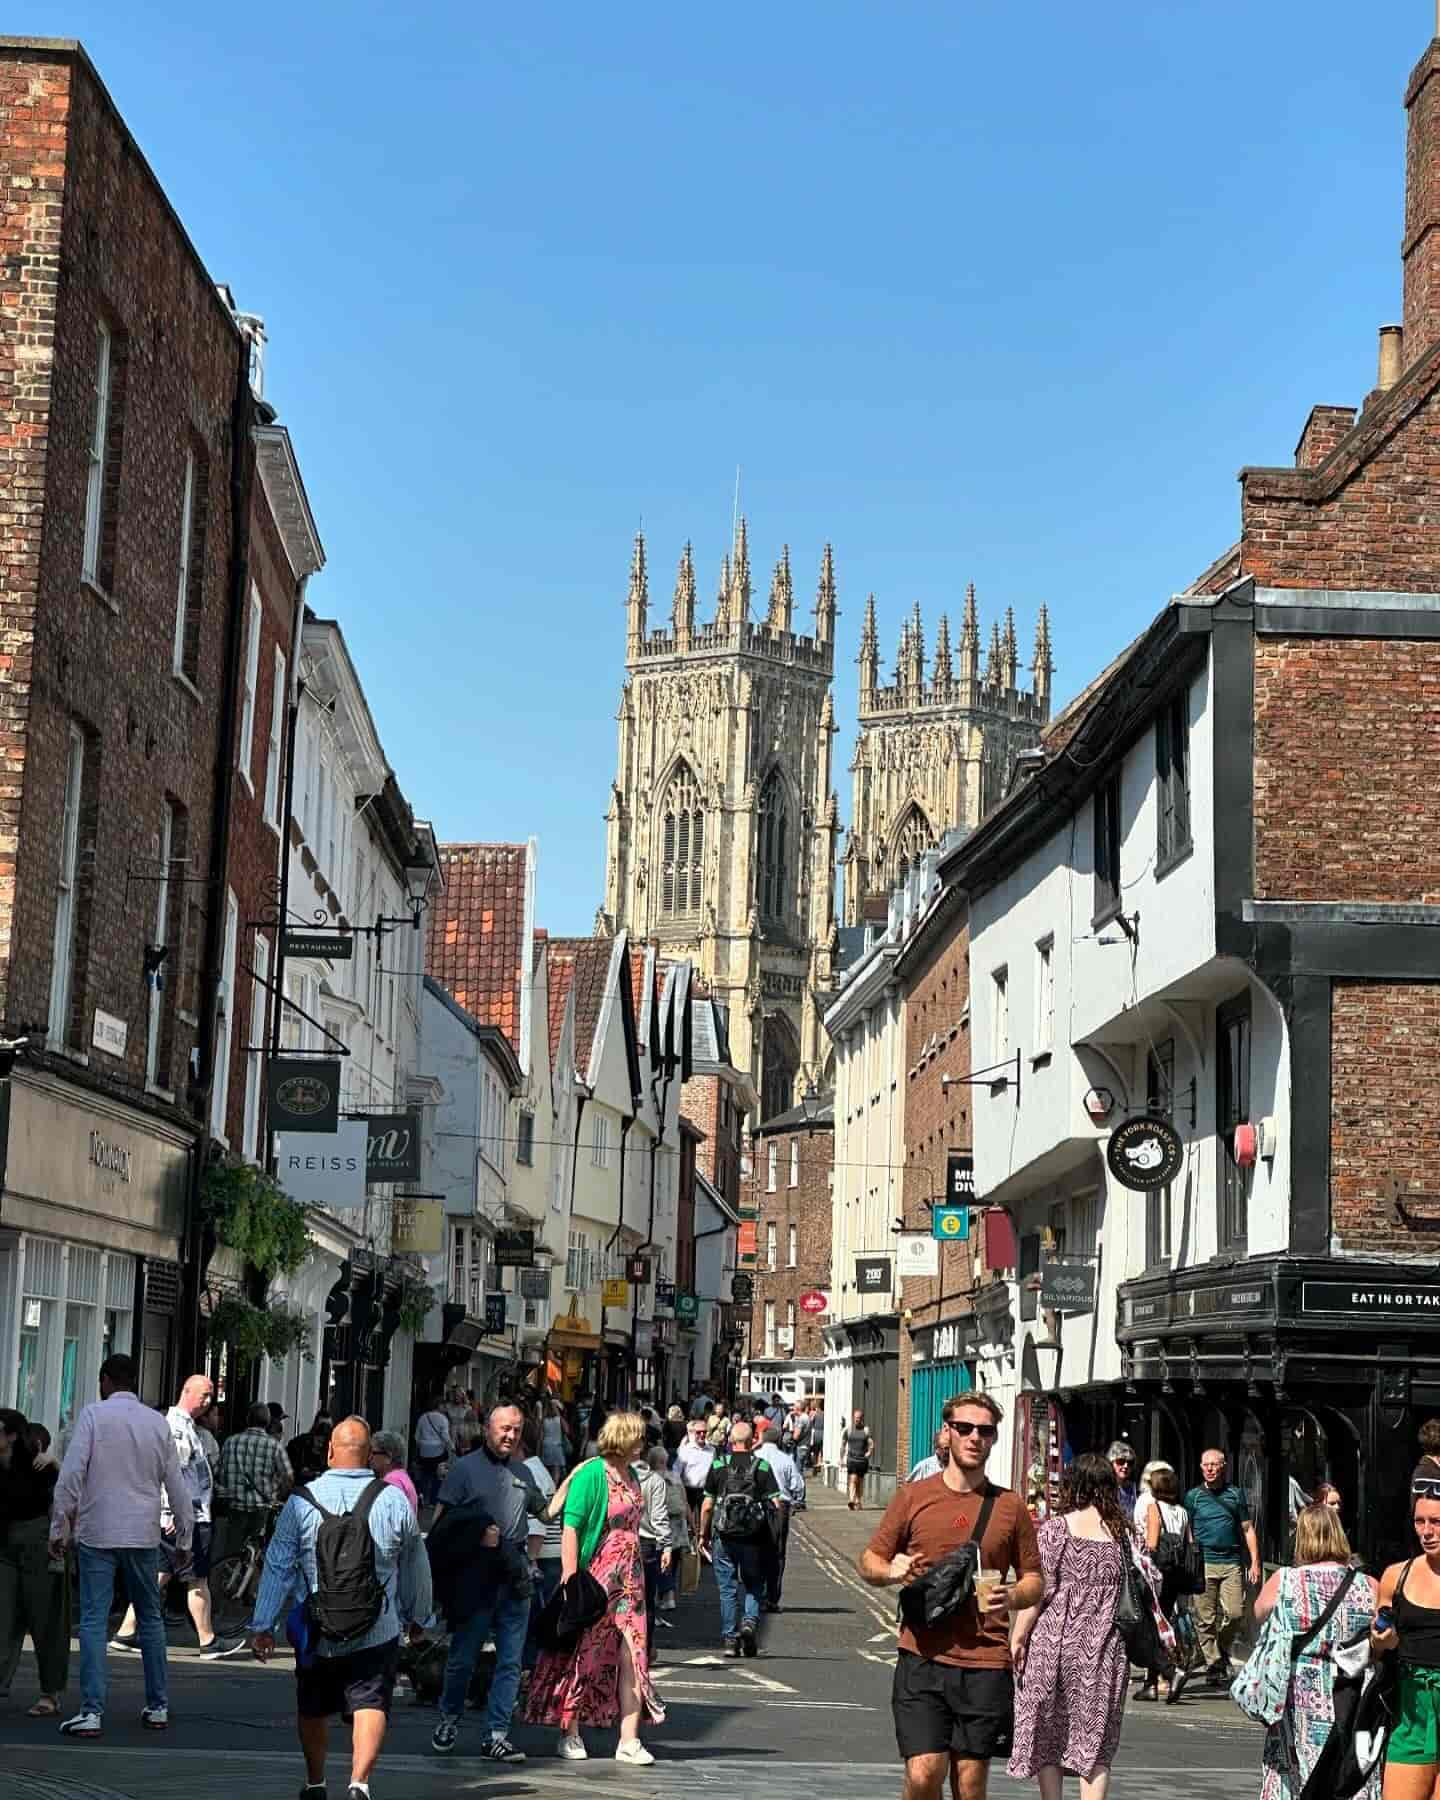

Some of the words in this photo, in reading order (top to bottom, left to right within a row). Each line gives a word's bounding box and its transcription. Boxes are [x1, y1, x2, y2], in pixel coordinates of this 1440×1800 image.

[288, 1155, 357, 1171] REISS
[1352, 1293, 1375, 1304] EAT
[1379, 1294, 1392, 1304] IN
[1395, 1295, 1413, 1305] OR
[1415, 1295, 1440, 1305] TAK
